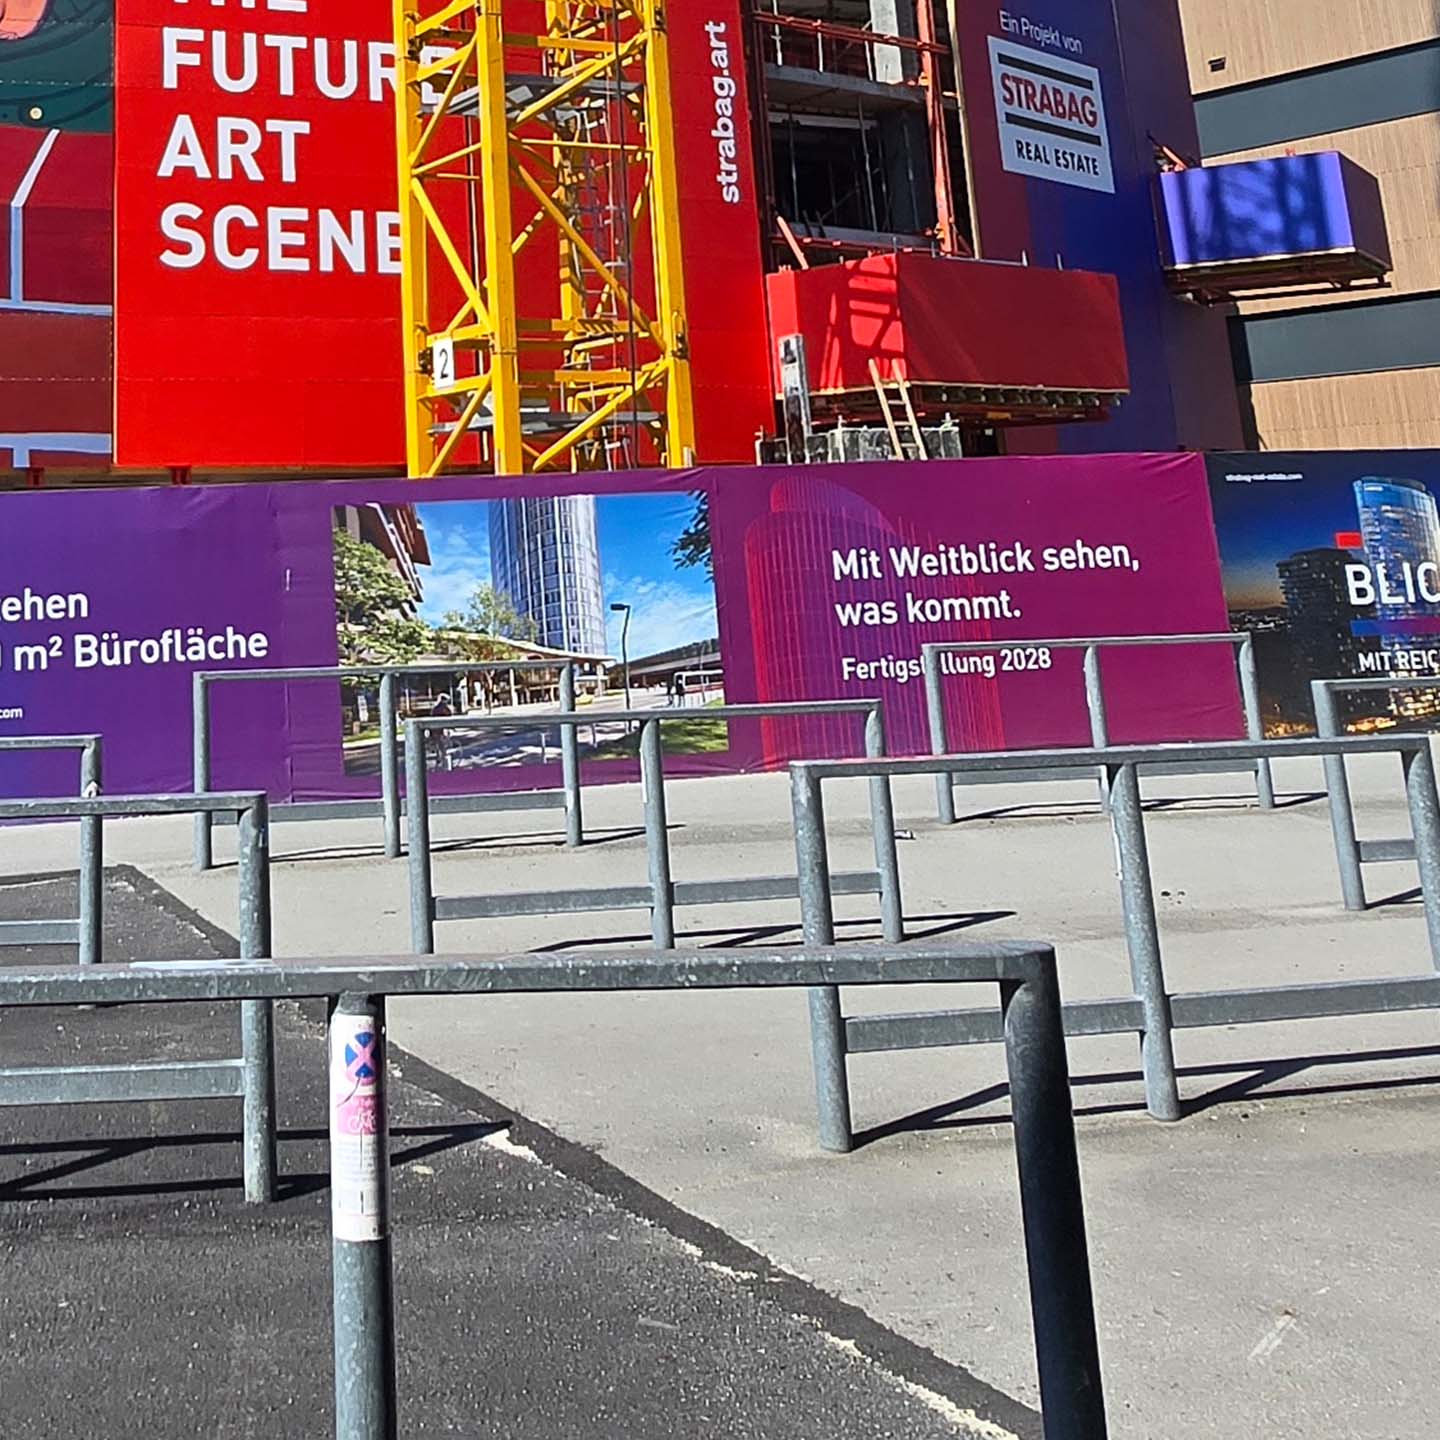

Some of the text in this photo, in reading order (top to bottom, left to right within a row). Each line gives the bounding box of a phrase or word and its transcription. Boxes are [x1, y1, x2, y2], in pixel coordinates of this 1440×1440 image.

[999, 10, 1083, 54] Ein Projekt von
[161, 26, 456, 106] FUTURE
[704, 21, 740, 204] strabag.art
[1000, 72, 1098, 128] STRABAG
[157, 114, 310, 183] ART
[1016, 139, 1100, 176] REAL ESTATE
[159, 202, 403, 274] SCENE
[438, 347, 449, 380] 2
[831, 538, 1140, 580] Mit Weitblick sehen,
[835, 590, 1022, 627] was kommt.
[14, 635, 64, 672] m²
[74, 625, 268, 669] Bürofläche
[841, 647, 1052, 683] Fertigstllung 2028
[1357, 652, 1392, 672] MIT
